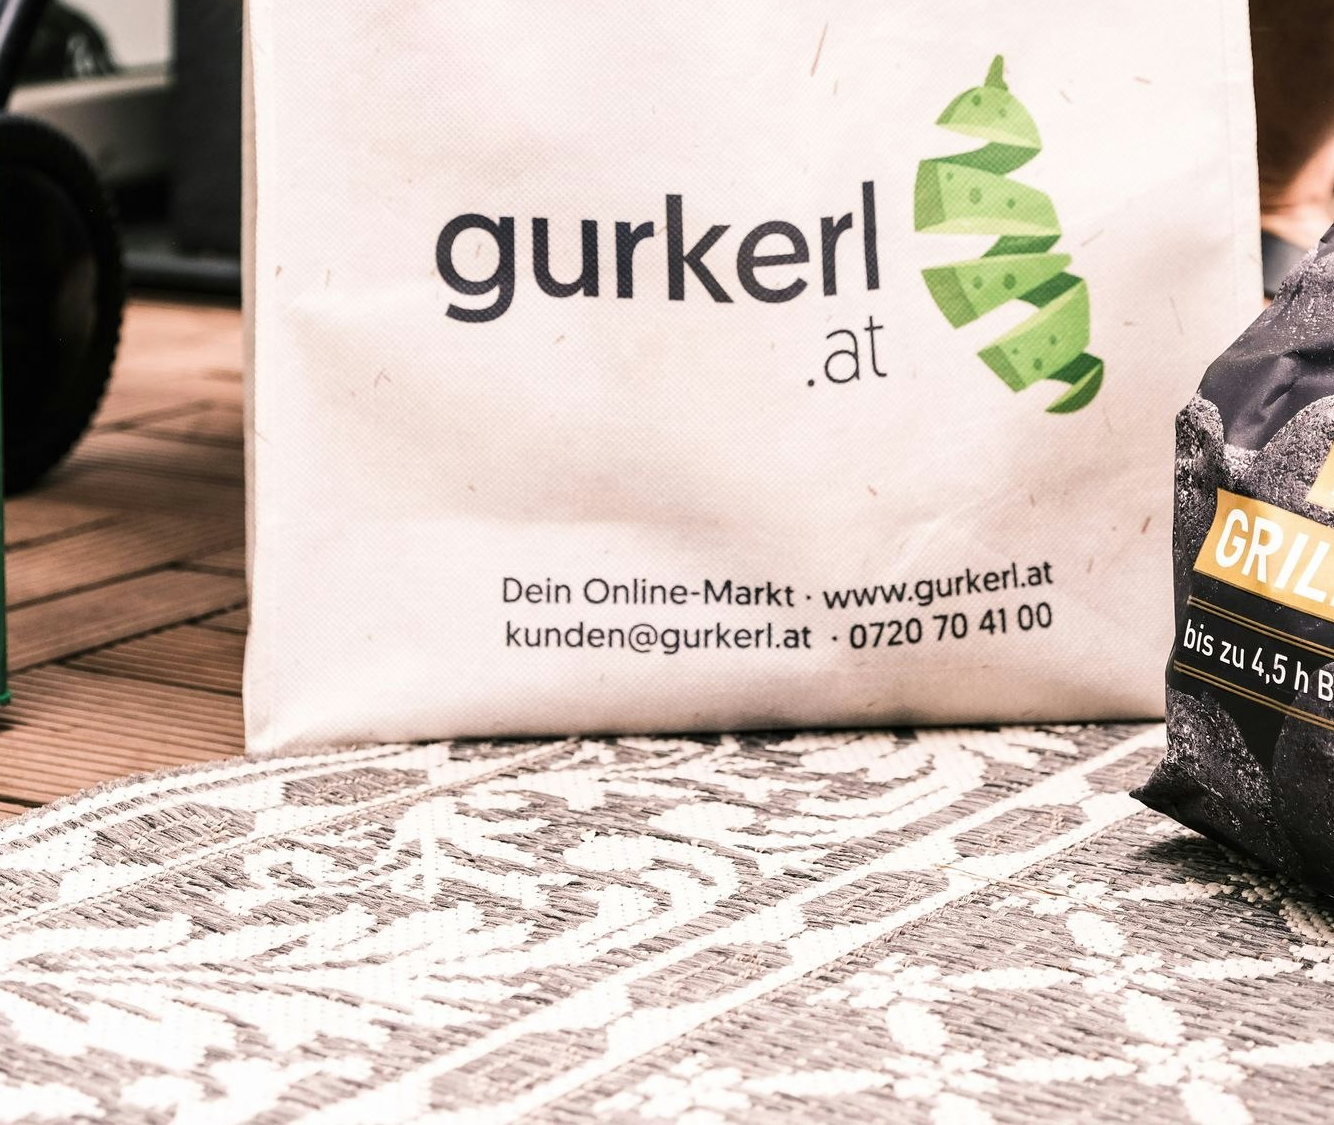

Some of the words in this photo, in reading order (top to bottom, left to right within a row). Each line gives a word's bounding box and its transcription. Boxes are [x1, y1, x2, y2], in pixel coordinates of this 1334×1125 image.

[435, 180, 880, 324] gurkerl
[807, 315, 887, 388] .at
[503, 577, 572, 605] Dein
[583, 577, 796, 608] Online-Markt
[823, 559, 1055, 610] www.gurkerl.at
[505, 620, 812, 655] kunden@gurkerl.at
[849, 617, 923, 650] 0720
[933, 612, 968, 640] 70
[979, 607, 1008, 635] 41
[1017, 601, 1053, 630] 00
[1181, 619, 1215, 656] bis
[1219, 641, 1247, 670] zu
[1250, 647, 1288, 685] 4,5
[1293, 660, 1311, 694] h
